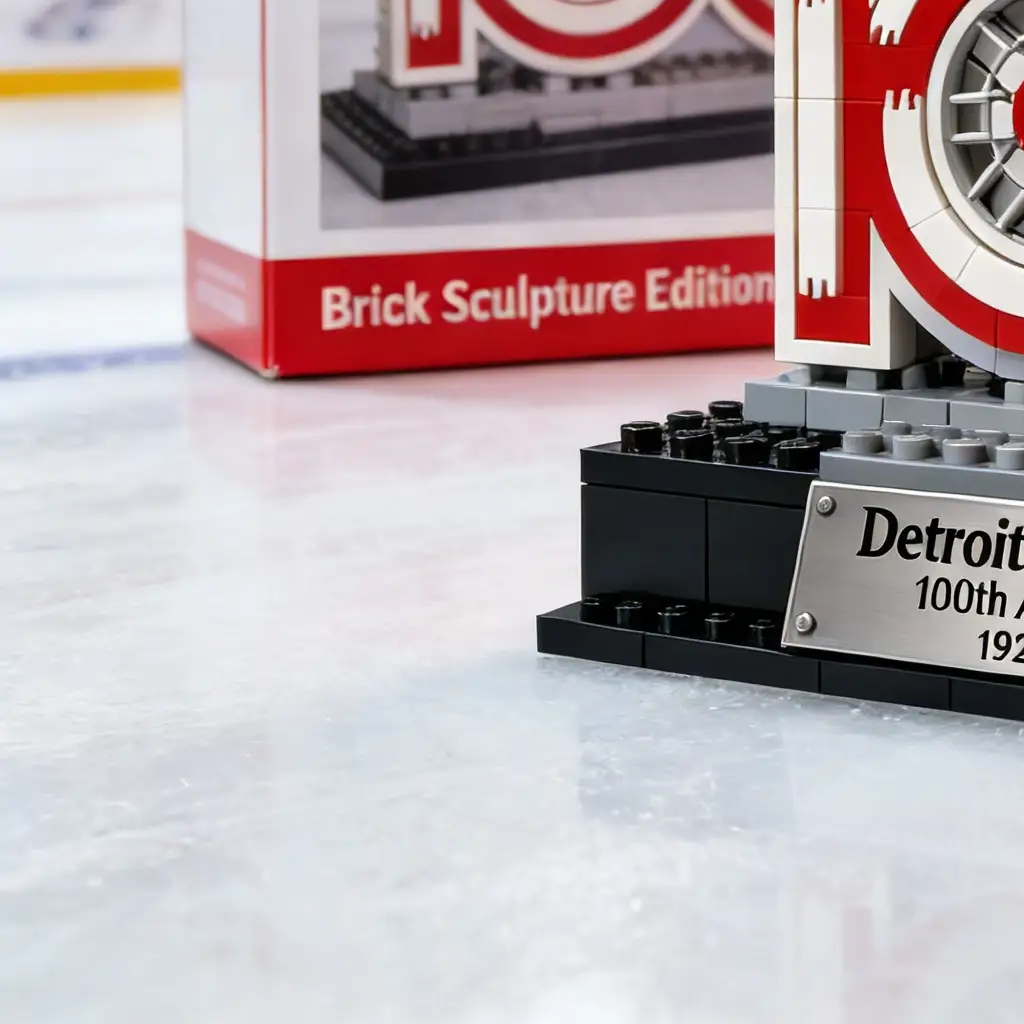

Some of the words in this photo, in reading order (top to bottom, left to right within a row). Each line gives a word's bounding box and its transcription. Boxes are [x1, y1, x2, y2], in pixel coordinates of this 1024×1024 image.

[320, 281, 431, 331] Brick
[441, 274, 635, 329] Sculpture
[645, 263, 776, 311] Edition
[914, 575, 1009, 619] 100th
